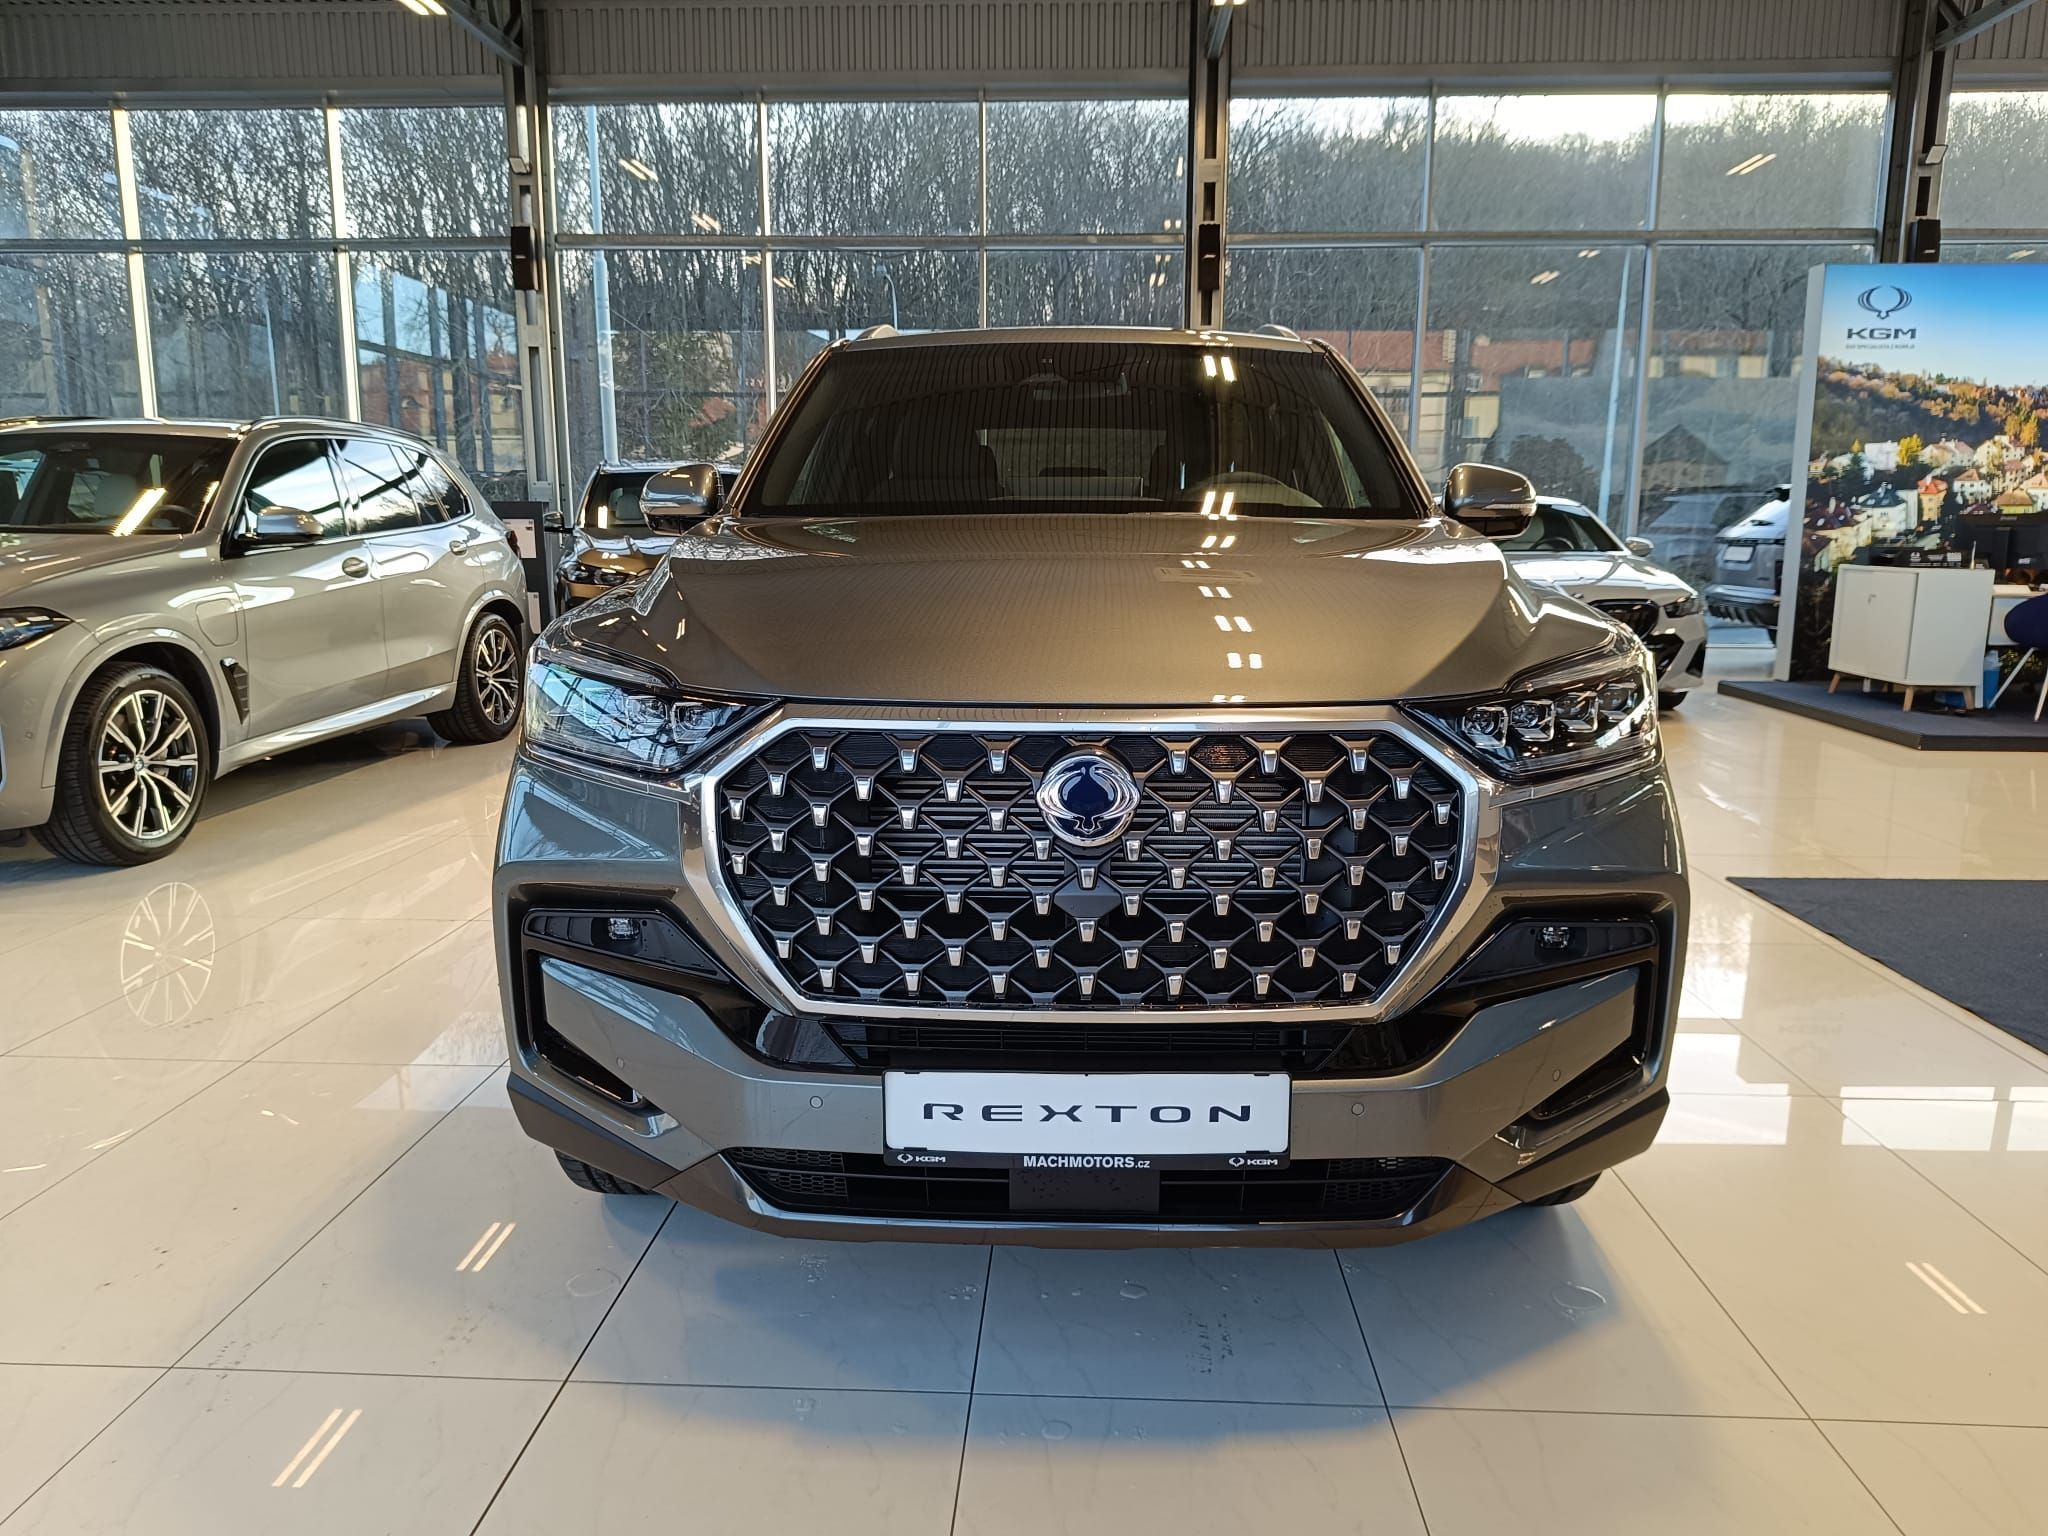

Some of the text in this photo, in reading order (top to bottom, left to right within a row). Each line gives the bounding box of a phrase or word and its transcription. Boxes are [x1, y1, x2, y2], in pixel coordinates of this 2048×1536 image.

[1847, 328, 1917, 340] KGM
[923, 1103, 1251, 1123] REXTON
[915, 1155, 946, 1163] KGM
[1023, 1155, 1151, 1169] MACHMOTORS.cz
